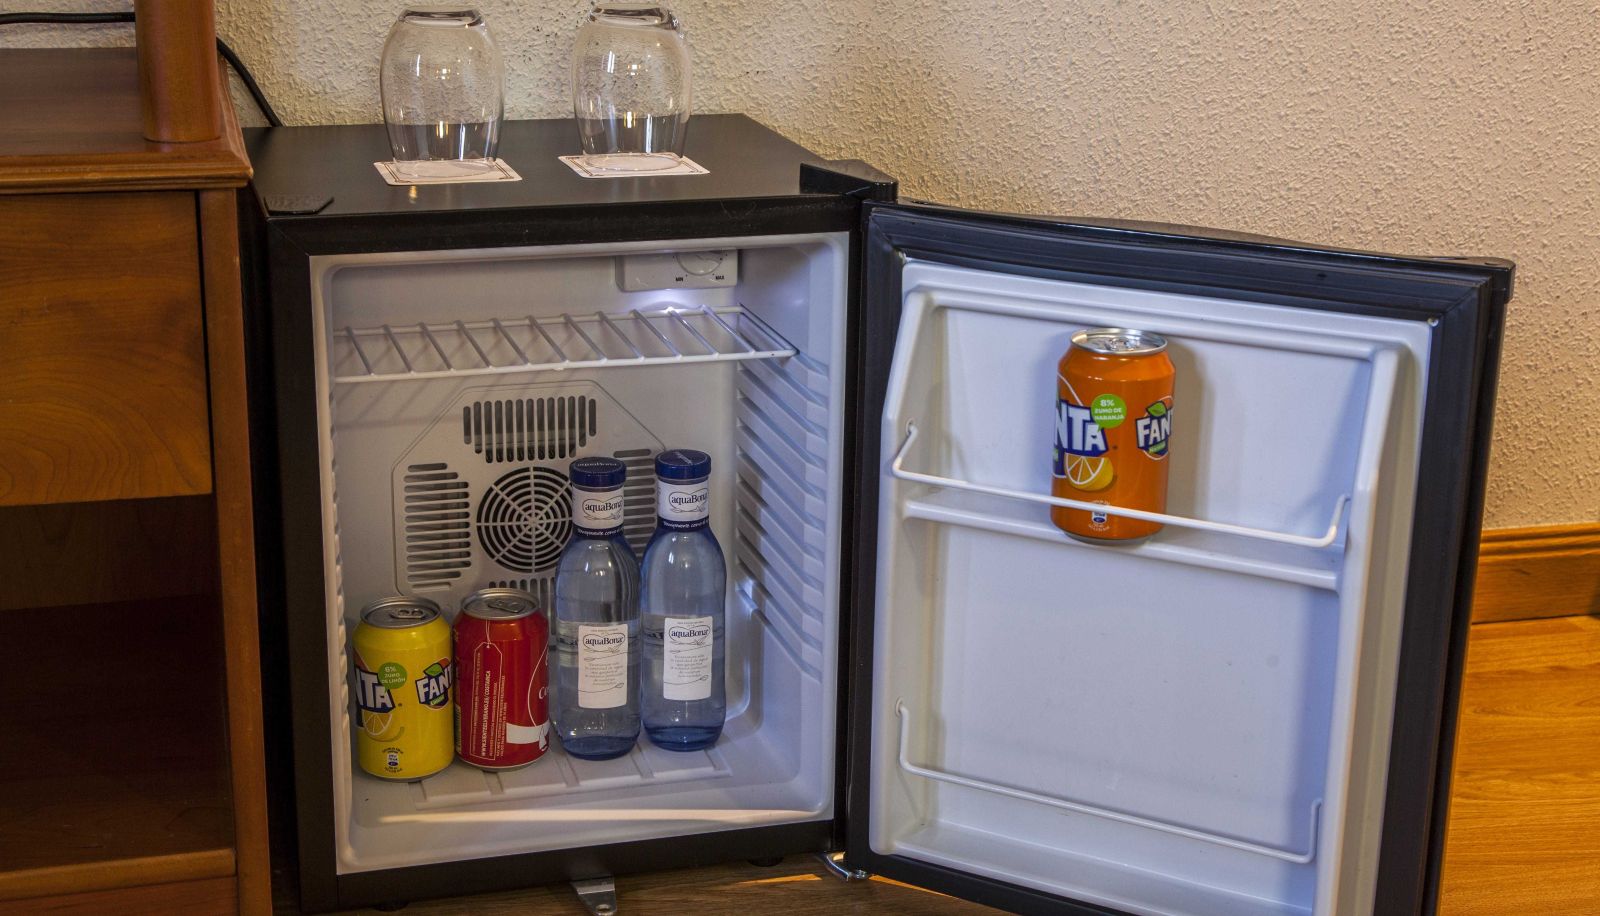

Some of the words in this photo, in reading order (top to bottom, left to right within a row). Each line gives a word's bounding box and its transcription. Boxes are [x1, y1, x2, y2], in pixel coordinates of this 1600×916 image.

[1100, 399, 1115, 407] 8%
[671, 629, 709, 639] aquaBona
[585, 636, 624, 647] aquaBona
